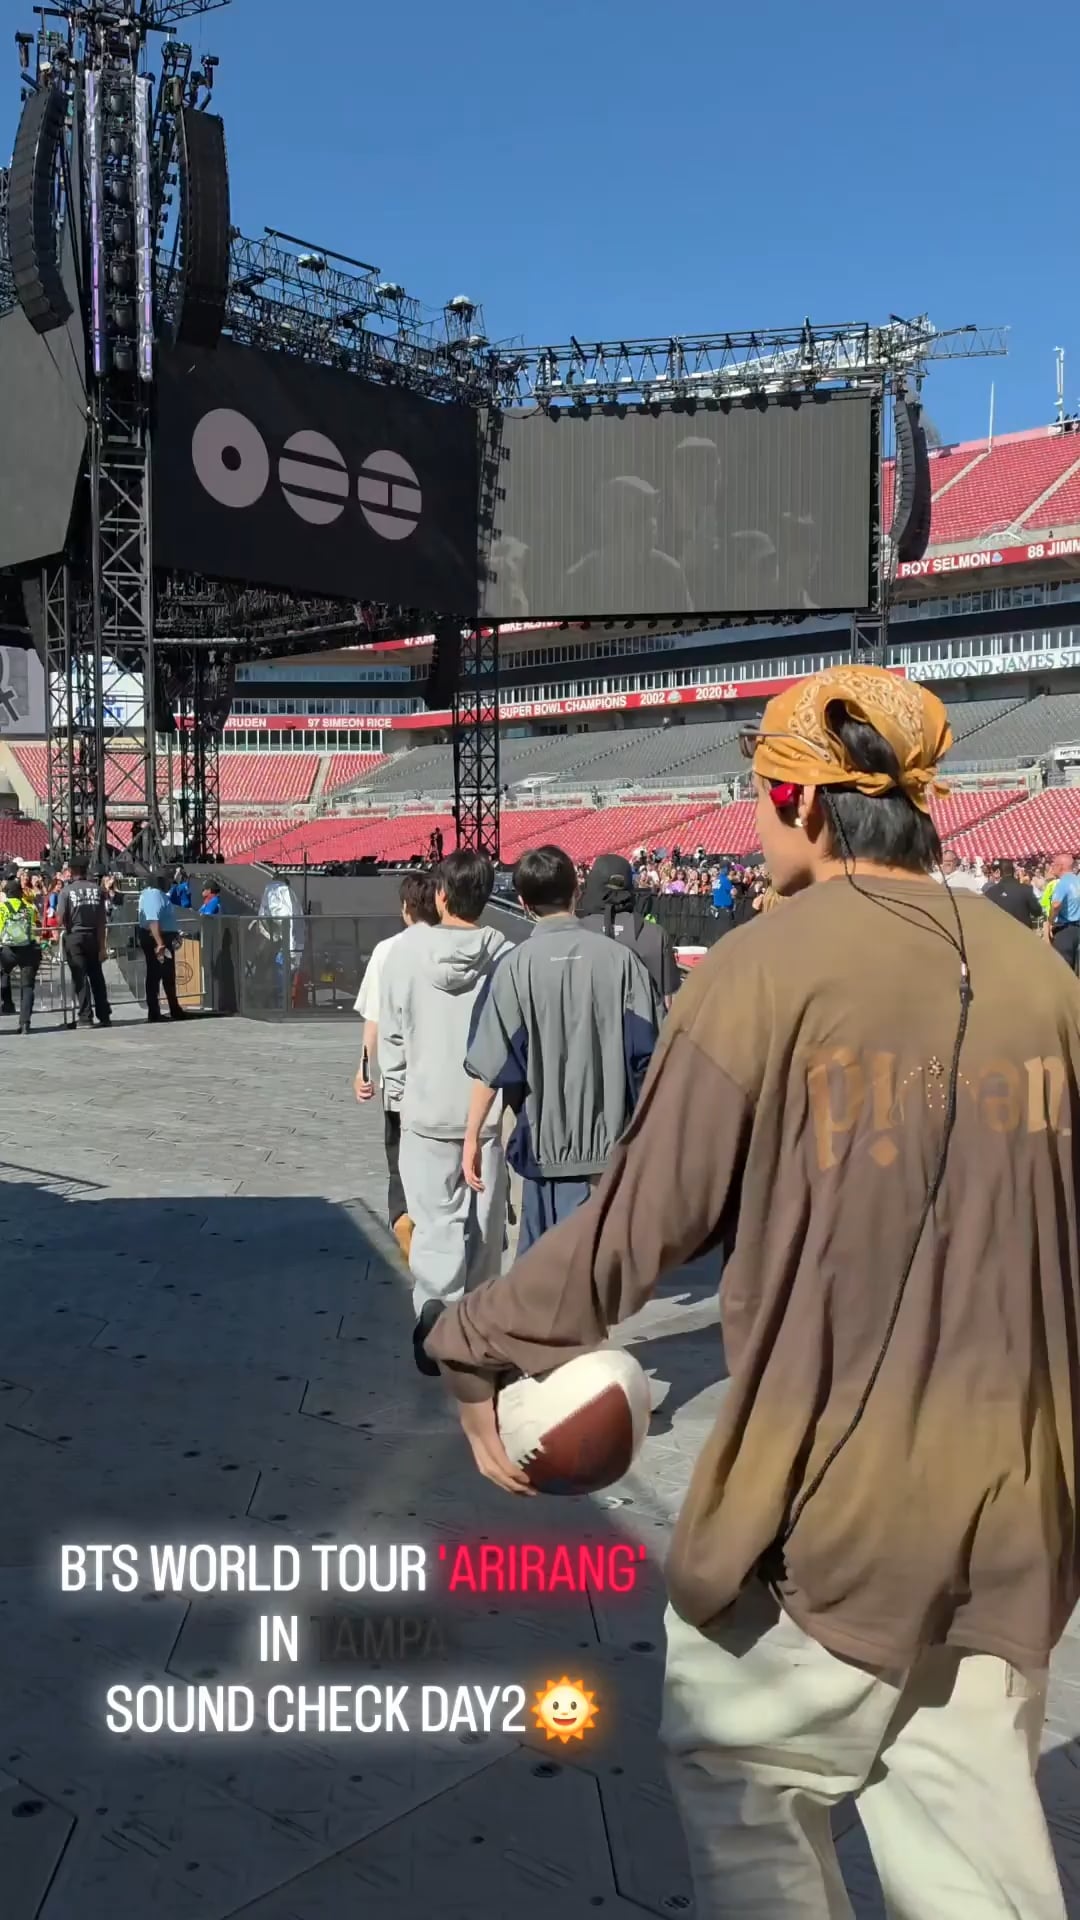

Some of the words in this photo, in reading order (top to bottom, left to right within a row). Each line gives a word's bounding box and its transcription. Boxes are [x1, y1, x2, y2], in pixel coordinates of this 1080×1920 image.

[1027, 544, 1044, 559] 88
[901, 560, 929, 577] ROY
[933, 552, 991, 572] SELMON
[907, 658, 993, 681] RAYMOND
[995, 652, 1055, 673] JAMES
[500, 704, 532, 719] SUPER
[534, 701, 564, 716] BOWL
[565, 695, 627, 713] CHAMPIONS
[640, 691, 665, 705] 2002
[695, 687, 722, 700] 2020
[307, 717, 320, 728] 97
[322, 717, 364, 728] SIMEON
[366, 717, 393, 728] RICE
